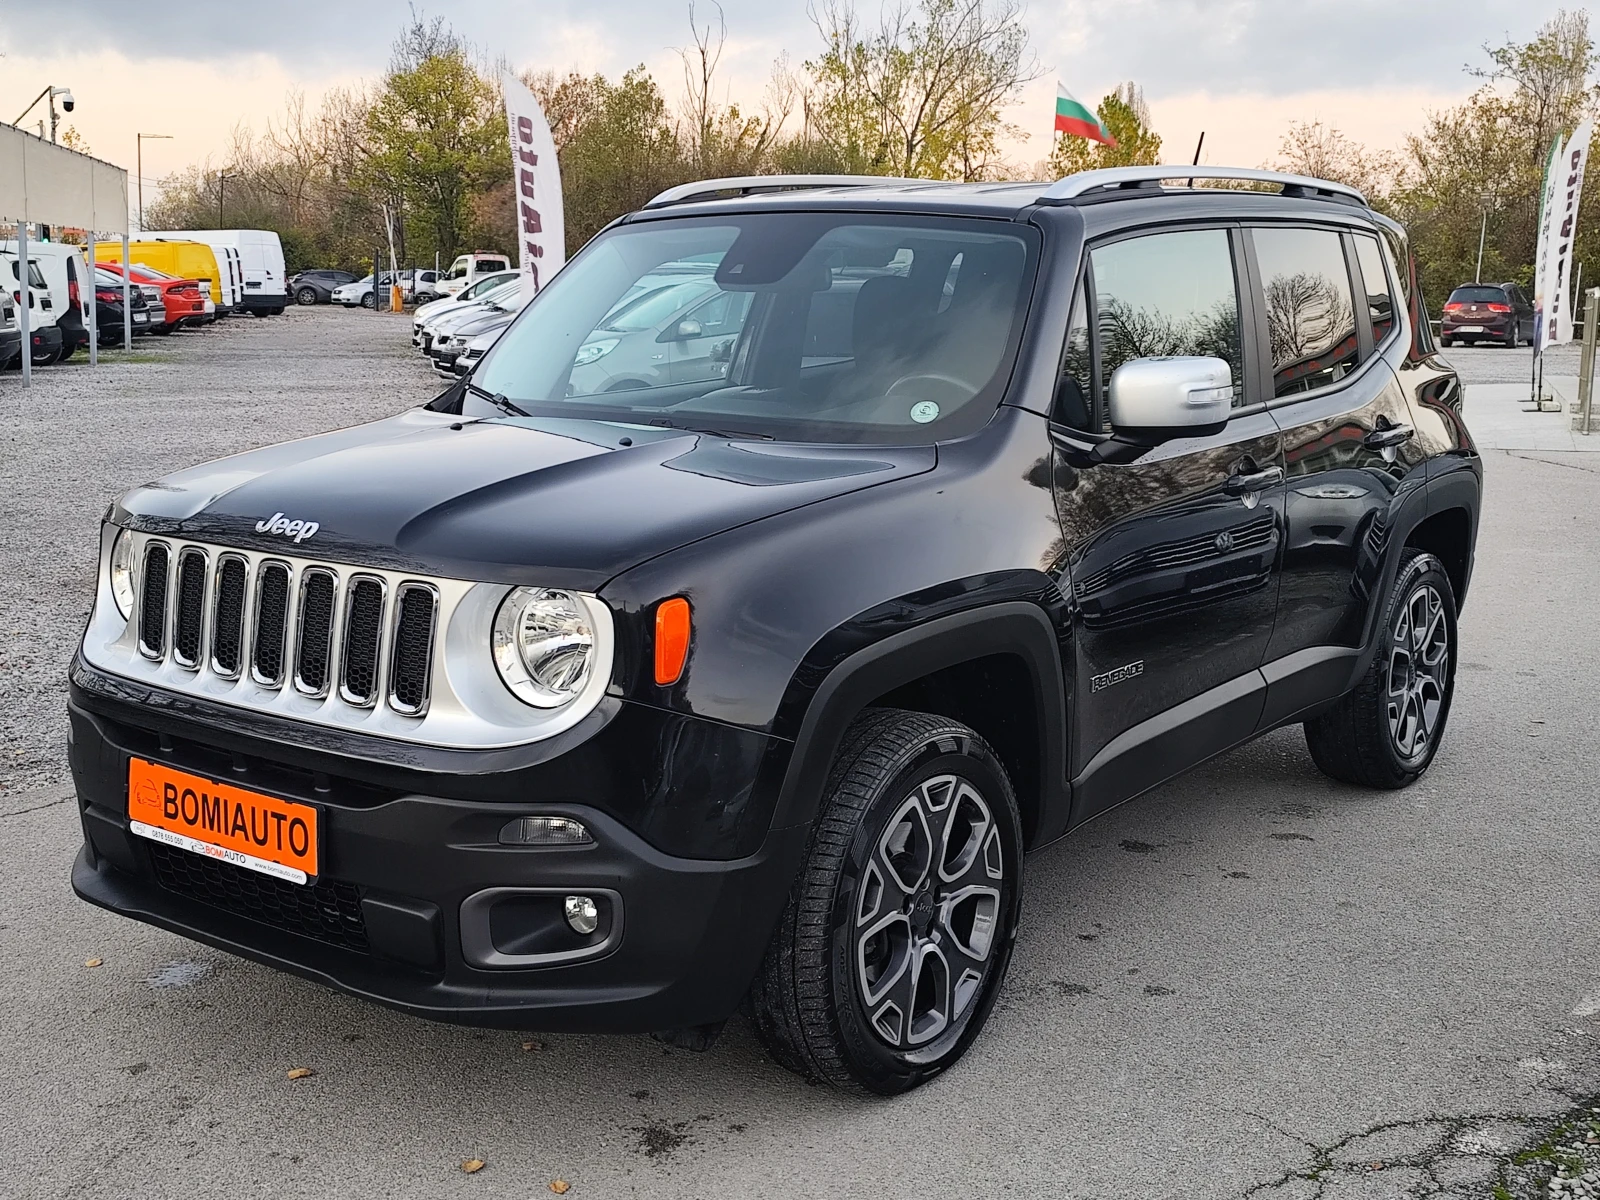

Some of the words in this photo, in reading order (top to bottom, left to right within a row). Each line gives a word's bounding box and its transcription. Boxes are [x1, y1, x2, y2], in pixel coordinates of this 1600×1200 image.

[255, 512, 320, 543] Jeep
[1090, 660, 1144, 693] RENEGADE
[164, 782, 309, 858] BOMIAUTO
[151, 829, 164, 840] 0878
[164, 833, 174, 843] 555
[205, 845, 246, 864] BOMIAUTO
[254, 861, 303, 881] www.bomiauto.com
